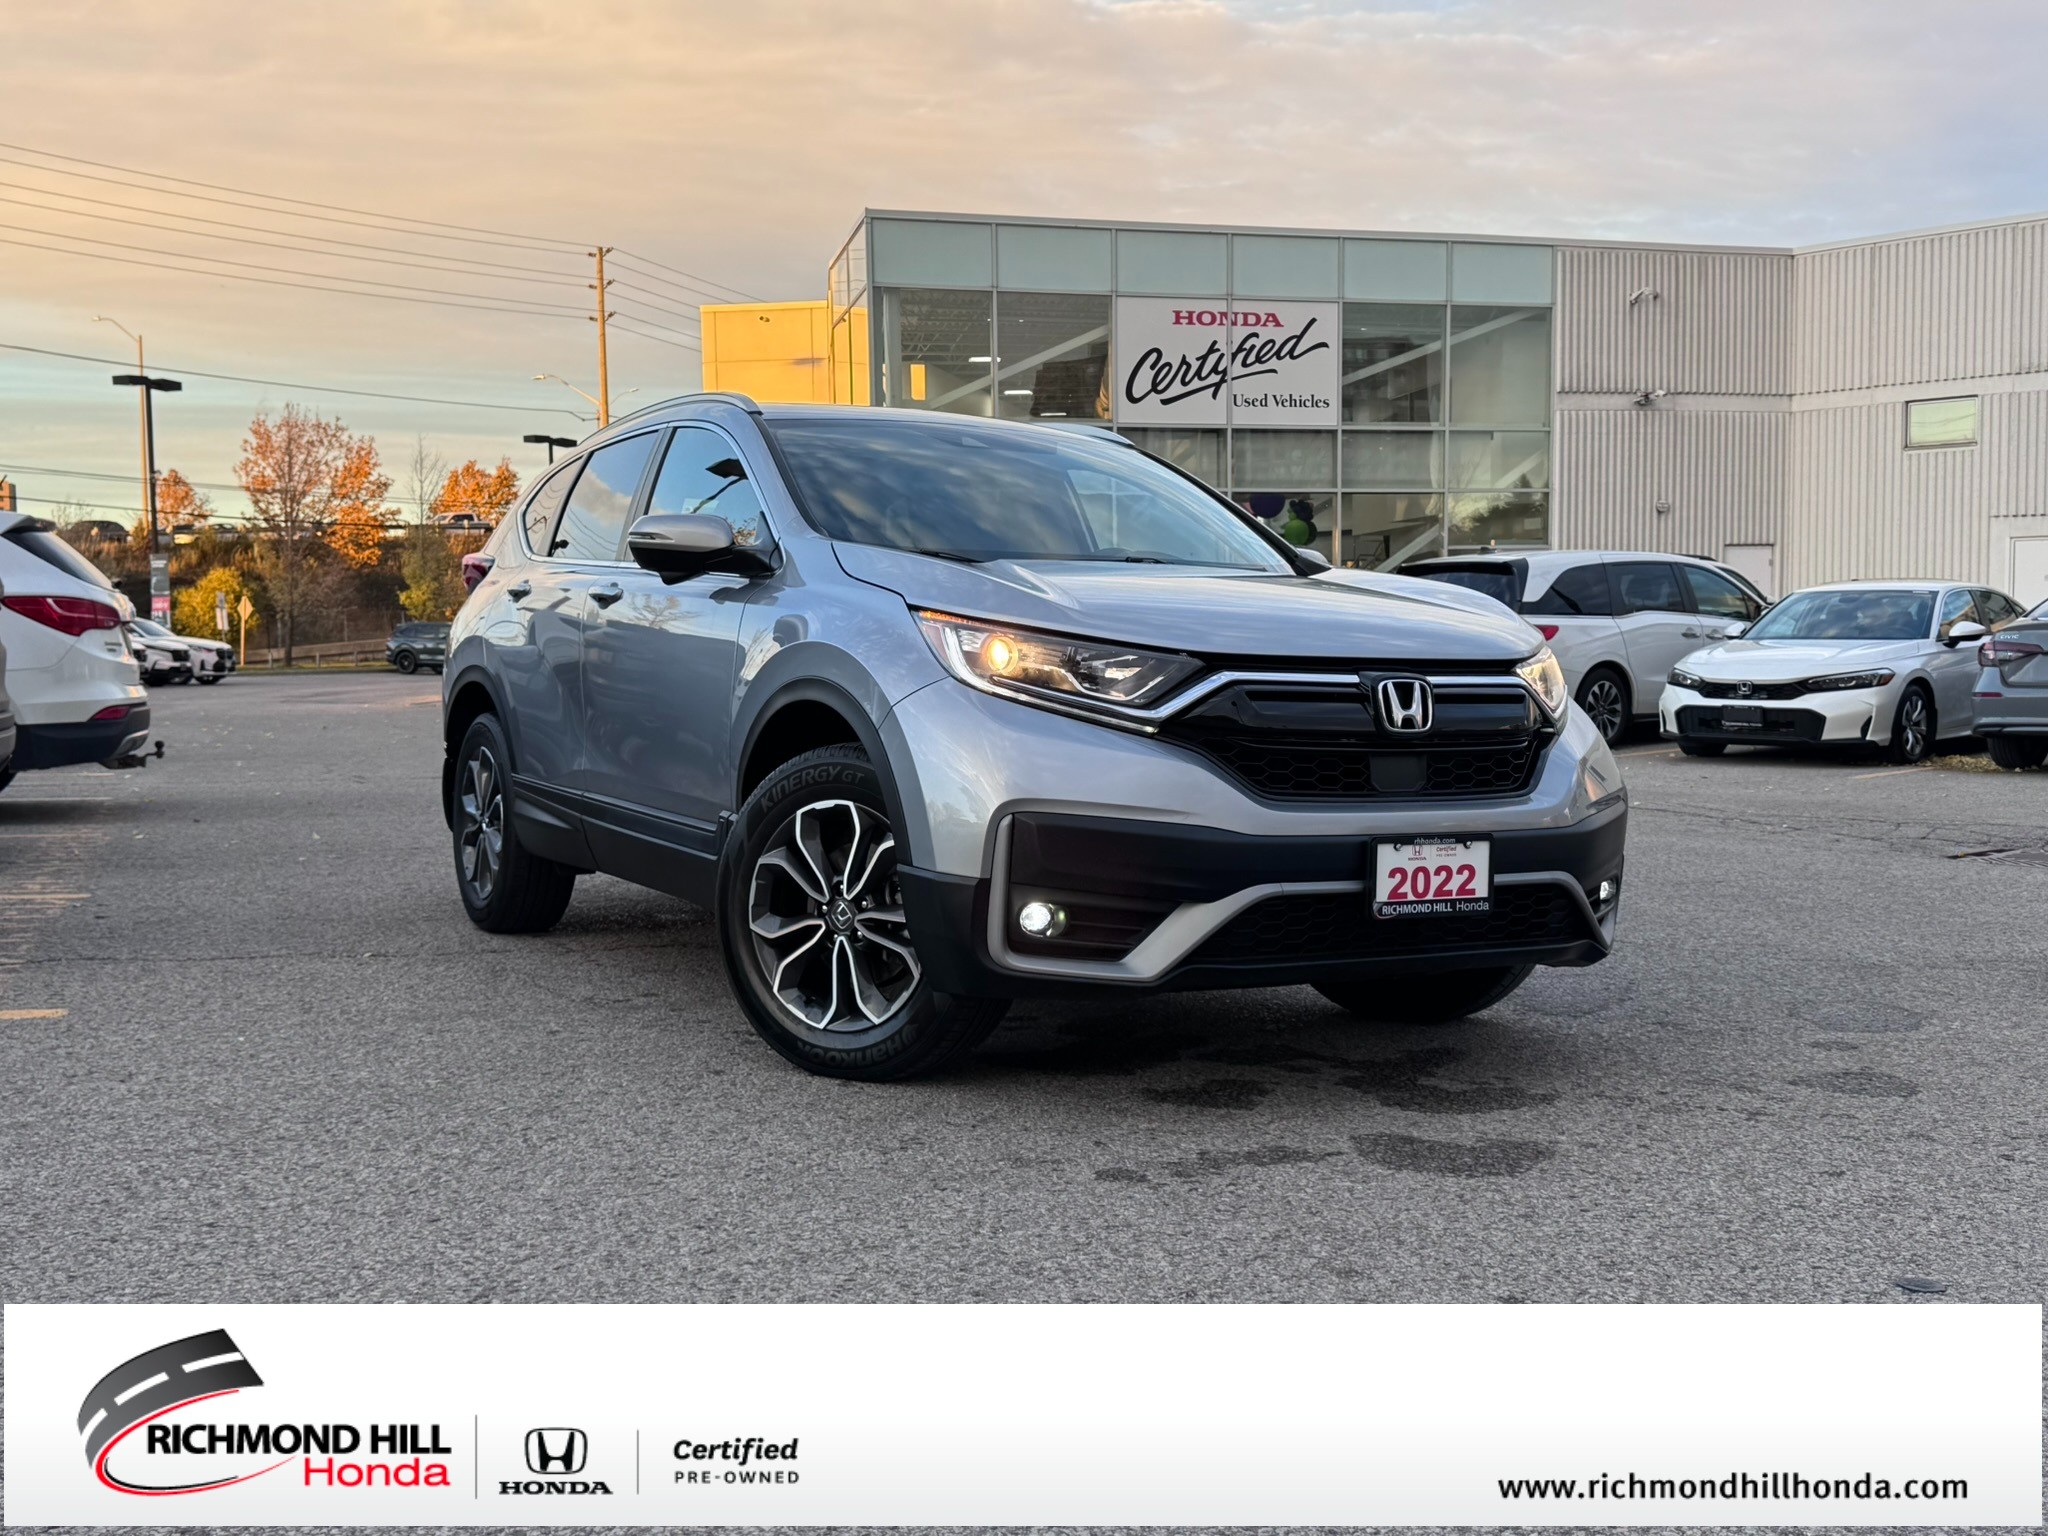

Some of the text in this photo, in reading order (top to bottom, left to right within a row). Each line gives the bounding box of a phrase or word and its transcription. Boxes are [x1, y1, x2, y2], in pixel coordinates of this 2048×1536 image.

[1172, 310, 1284, 328] HONDA
[1125, 317, 1330, 404] Certified
[1233, 394, 1330, 408] Used Vehicles
[842, 770, 865, 785] GT
[1387, 864, 1476, 901] 2022
[1382, 900, 1489, 915] RICHMOND HILL Honda
